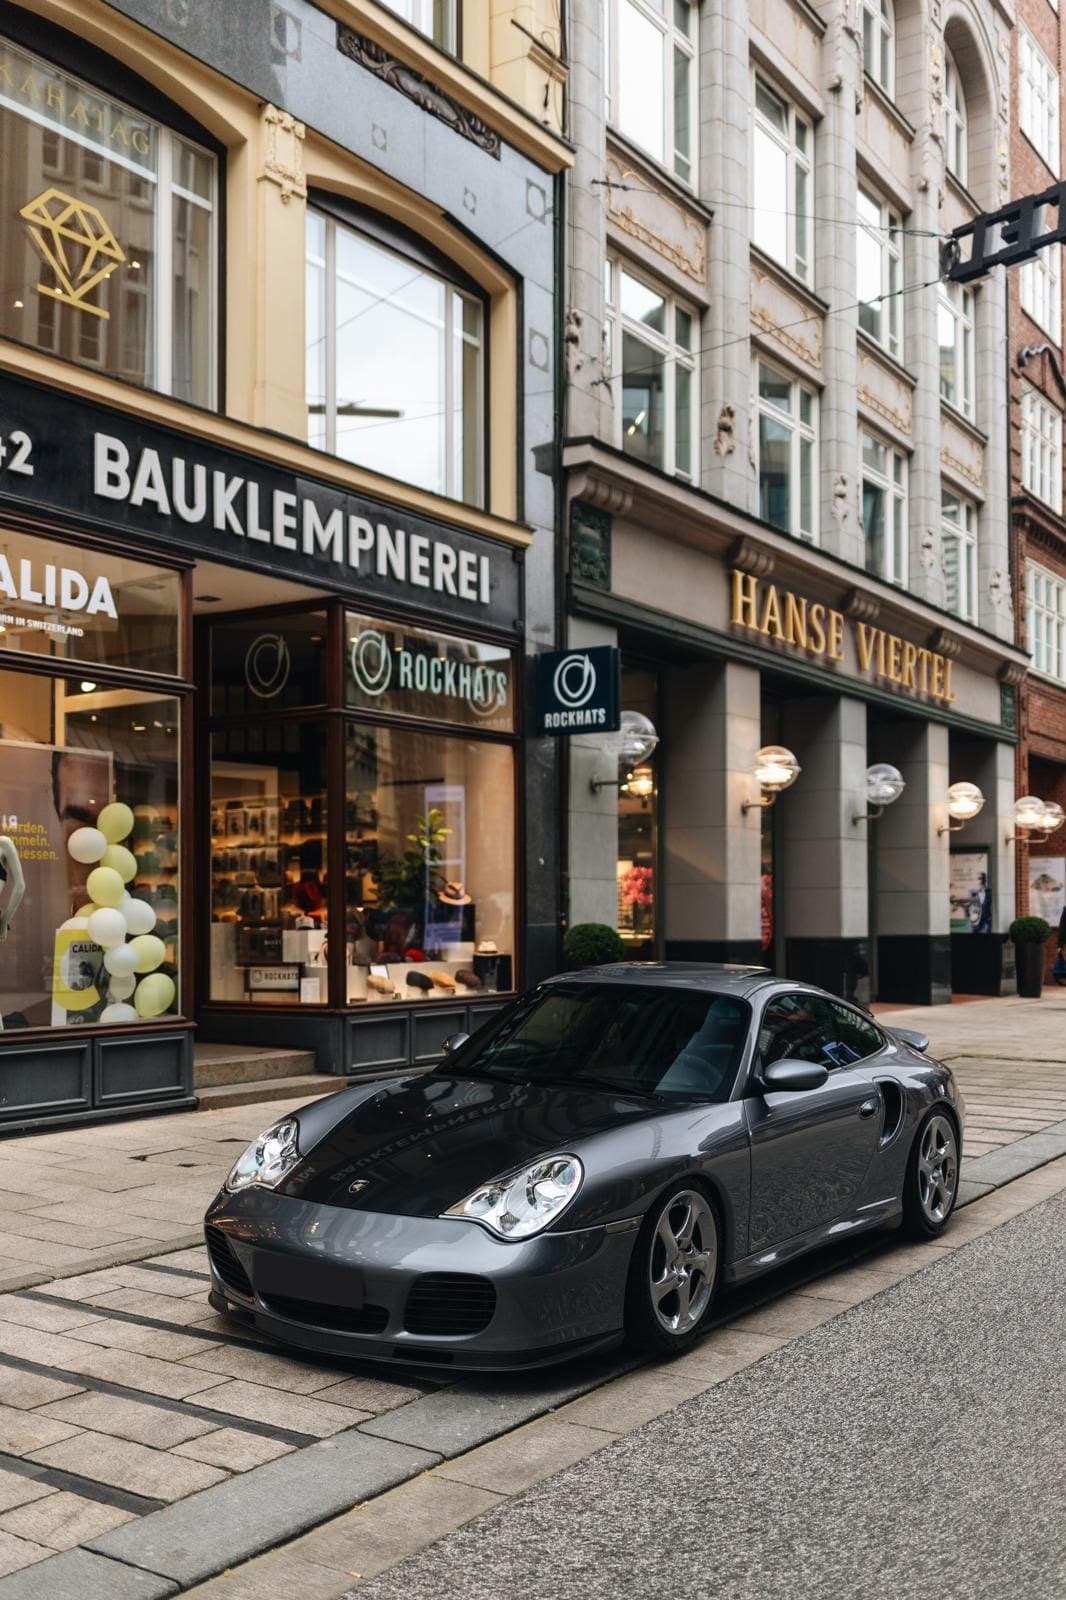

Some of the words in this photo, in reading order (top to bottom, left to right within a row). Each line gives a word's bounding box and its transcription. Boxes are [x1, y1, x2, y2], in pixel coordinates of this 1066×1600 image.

[0, 430, 34, 476] 2
[94, 432, 490, 604] BAUKLEMPNEREI
[27, 619, 84, 637] SWITZERLAND
[732, 569, 844, 661] HANSE
[856, 621, 955, 702] VIERTEL
[400, 650, 507, 706] ROCKHATS
[544, 708, 606, 728] ROCKHATS
[72, 944, 104, 954] CALIDA
